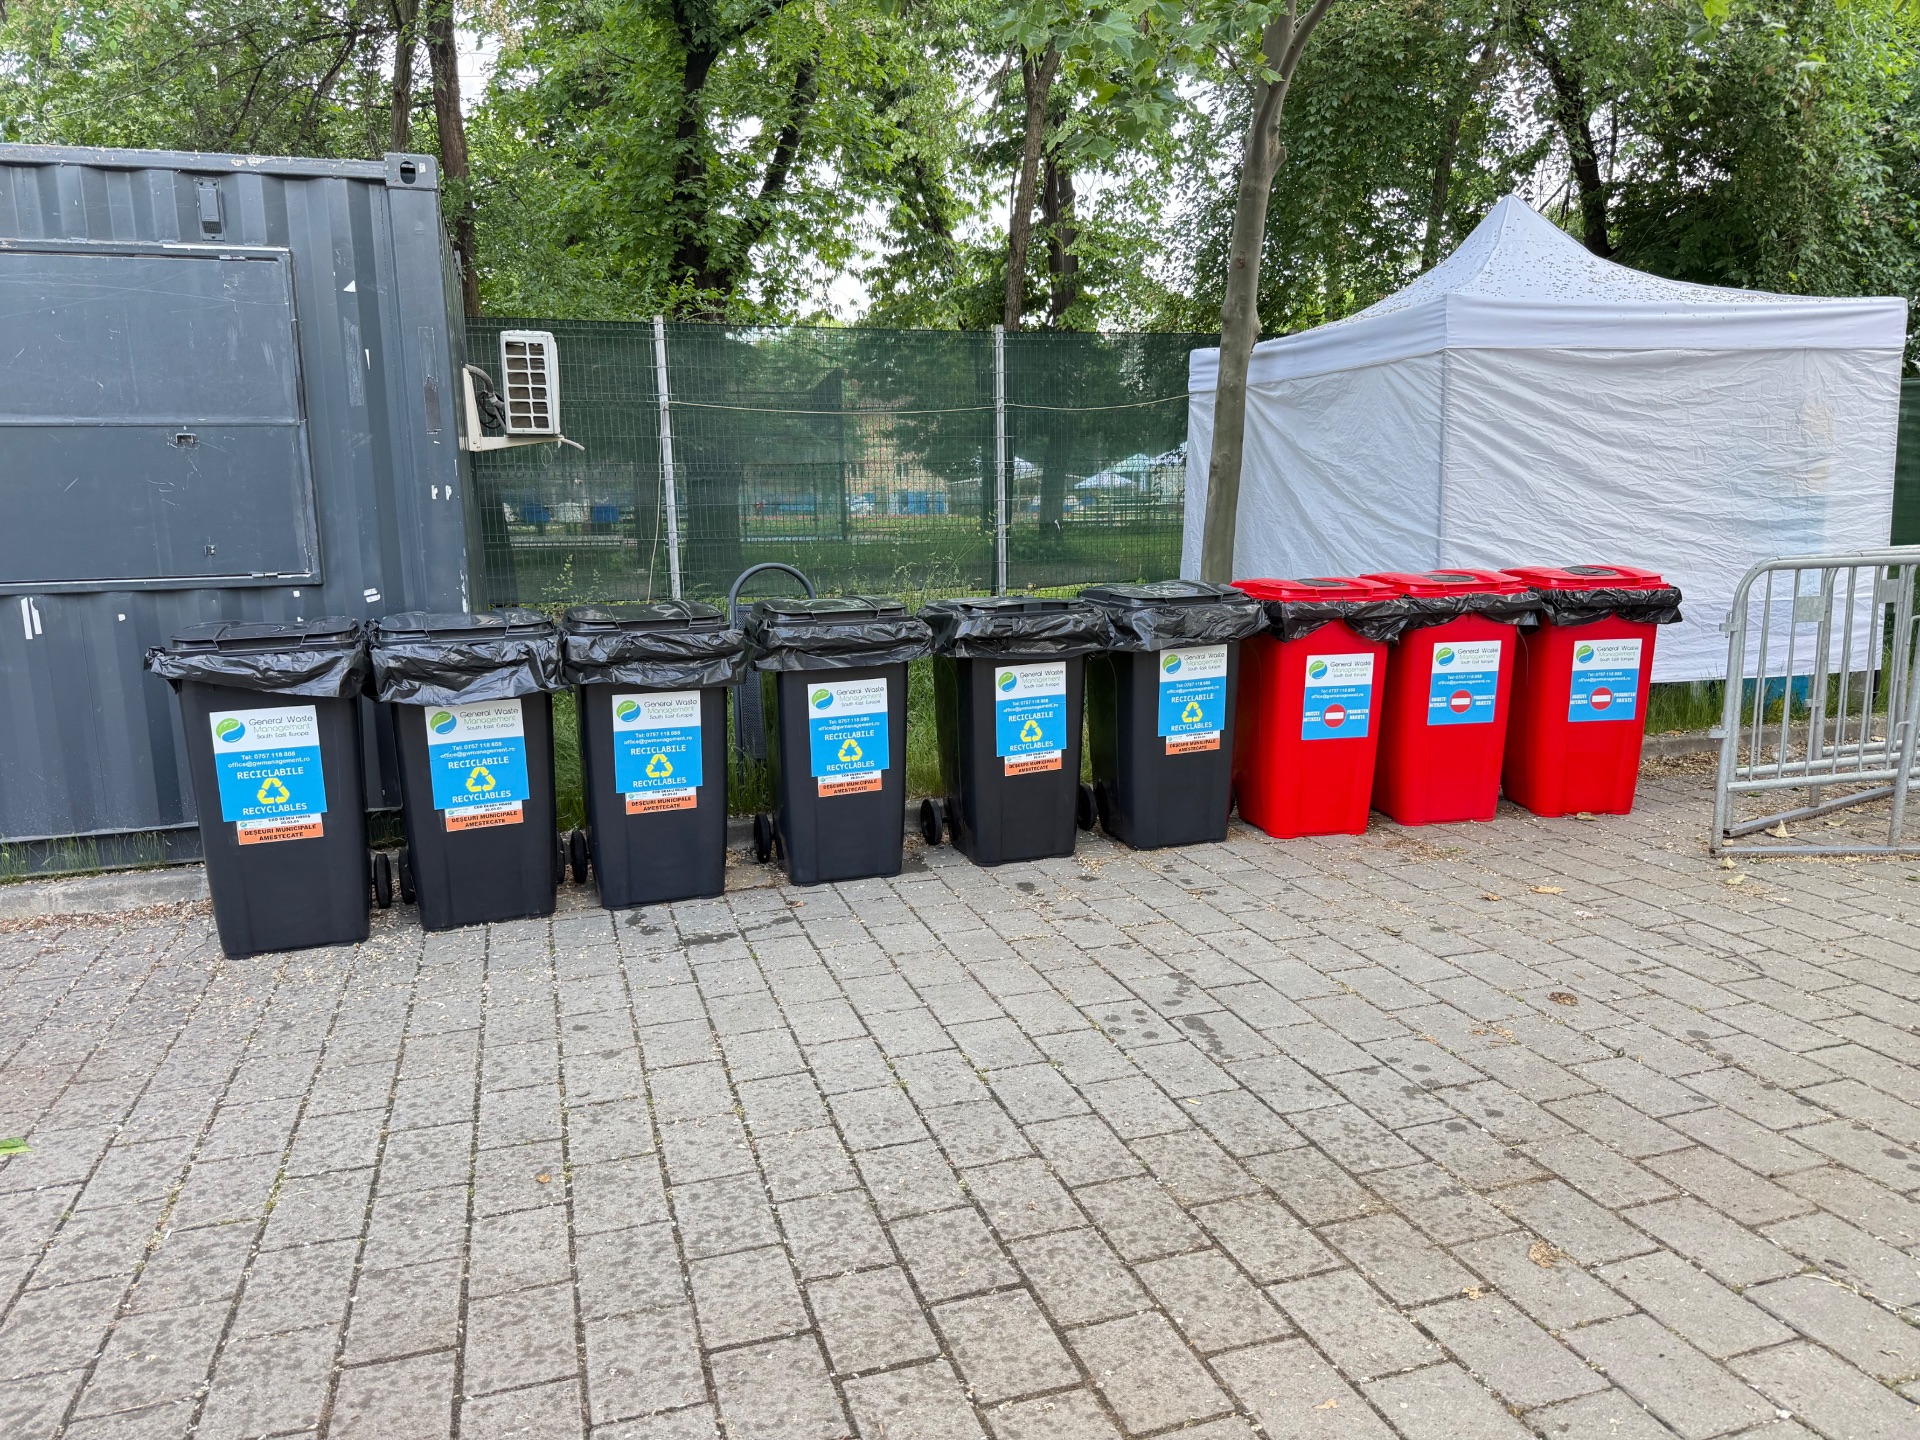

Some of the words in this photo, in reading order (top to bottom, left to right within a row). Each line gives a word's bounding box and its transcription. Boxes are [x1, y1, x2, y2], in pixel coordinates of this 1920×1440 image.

[1186, 658, 1222, 666] Management
[1022, 676, 1060, 684] Management
[837, 688, 861, 696] General
[840, 693, 882, 702] Management
[1172, 693, 1214, 703] RECICLABILE
[460, 709, 491, 718] General
[1009, 711, 1053, 722] RECICLABILE
[249, 717, 283, 726] General
[287, 715, 312, 723] Waste
[464, 716, 516, 725] Management
[253, 723, 310, 733] Management
[1171, 722, 1212, 731] RECYCLABLES
[825, 730, 874, 740] RECICLABILE
[631, 745, 686, 755] RECICLABILE
[1010, 741, 1053, 751] RECYCLABLES
[440, 747, 515, 758] office@gwmanagement.ro
[228, 757, 310, 768] office@gwmanagement.ro
[448, 757, 509, 769] RECICLABILE
[827, 761, 875, 771] RECYCLABLES
[237, 767, 304, 779] RECICLABILE
[633, 777, 686, 787] RECYCLABLES
[452, 790, 511, 803] RECYCLABLES
[243, 803, 307, 815] RECYCLABLES
[480, 811, 517, 820] MUNICIPALE
[465, 819, 505, 827] AMESTECATE
[276, 824, 316, 833] MUNICIPALE
[259, 832, 303, 841] AMESTECATE
